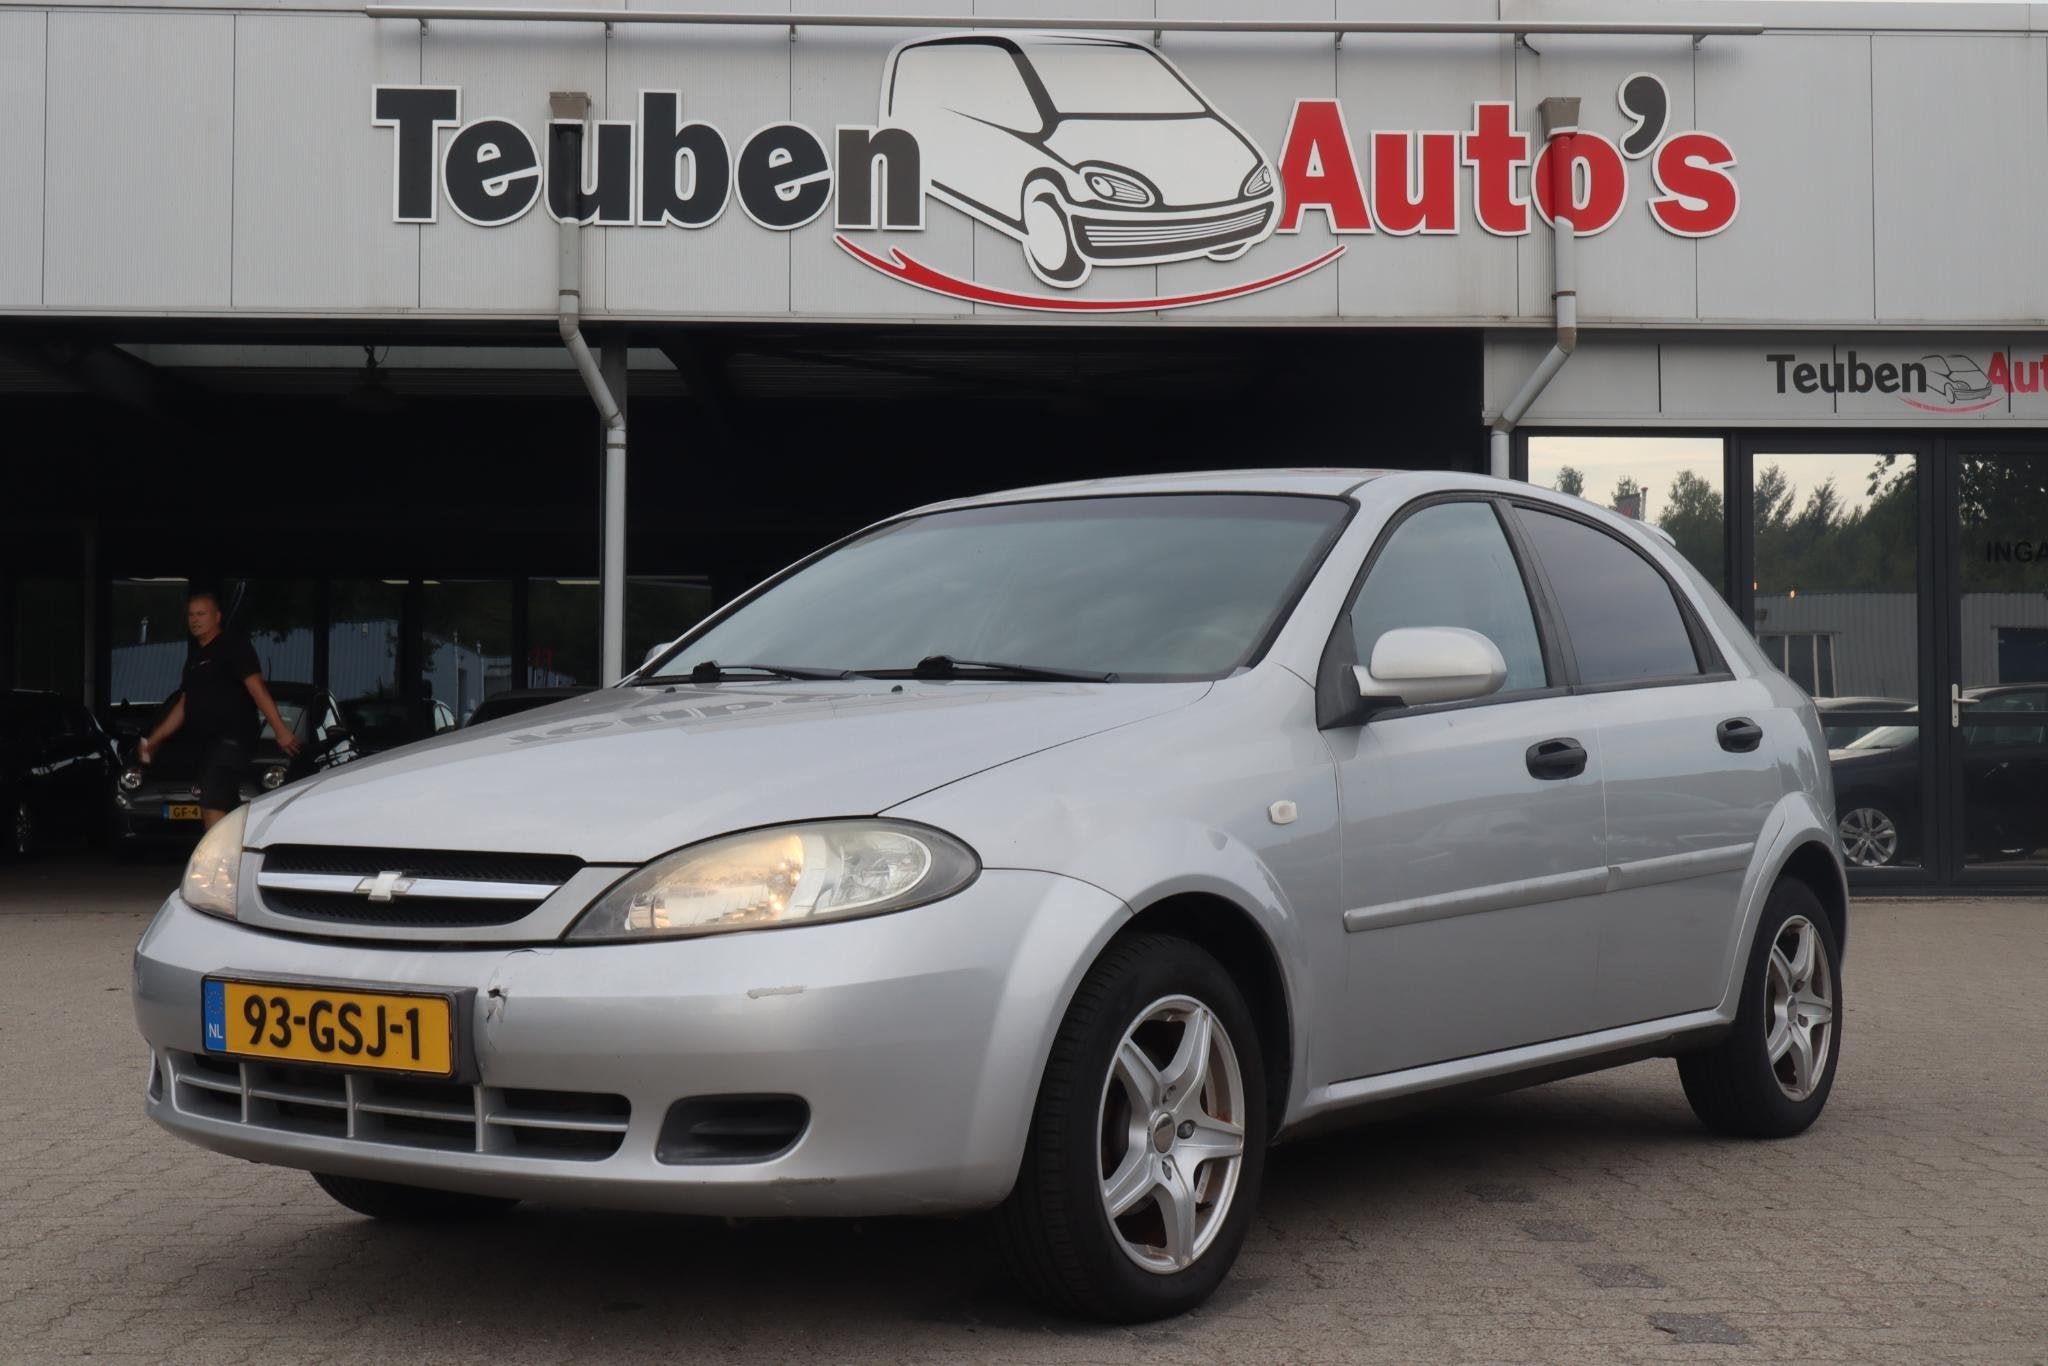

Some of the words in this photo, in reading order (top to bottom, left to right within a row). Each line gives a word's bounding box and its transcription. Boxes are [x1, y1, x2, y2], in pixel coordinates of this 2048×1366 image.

[373, 86, 924, 229] Teuben
[1277, 73, 1740, 236] Auto's
[1766, 351, 1927, 394] Teuben
[208, 1023, 224, 1040] NL
[243, 994, 420, 1061] 93-GSJ-1
